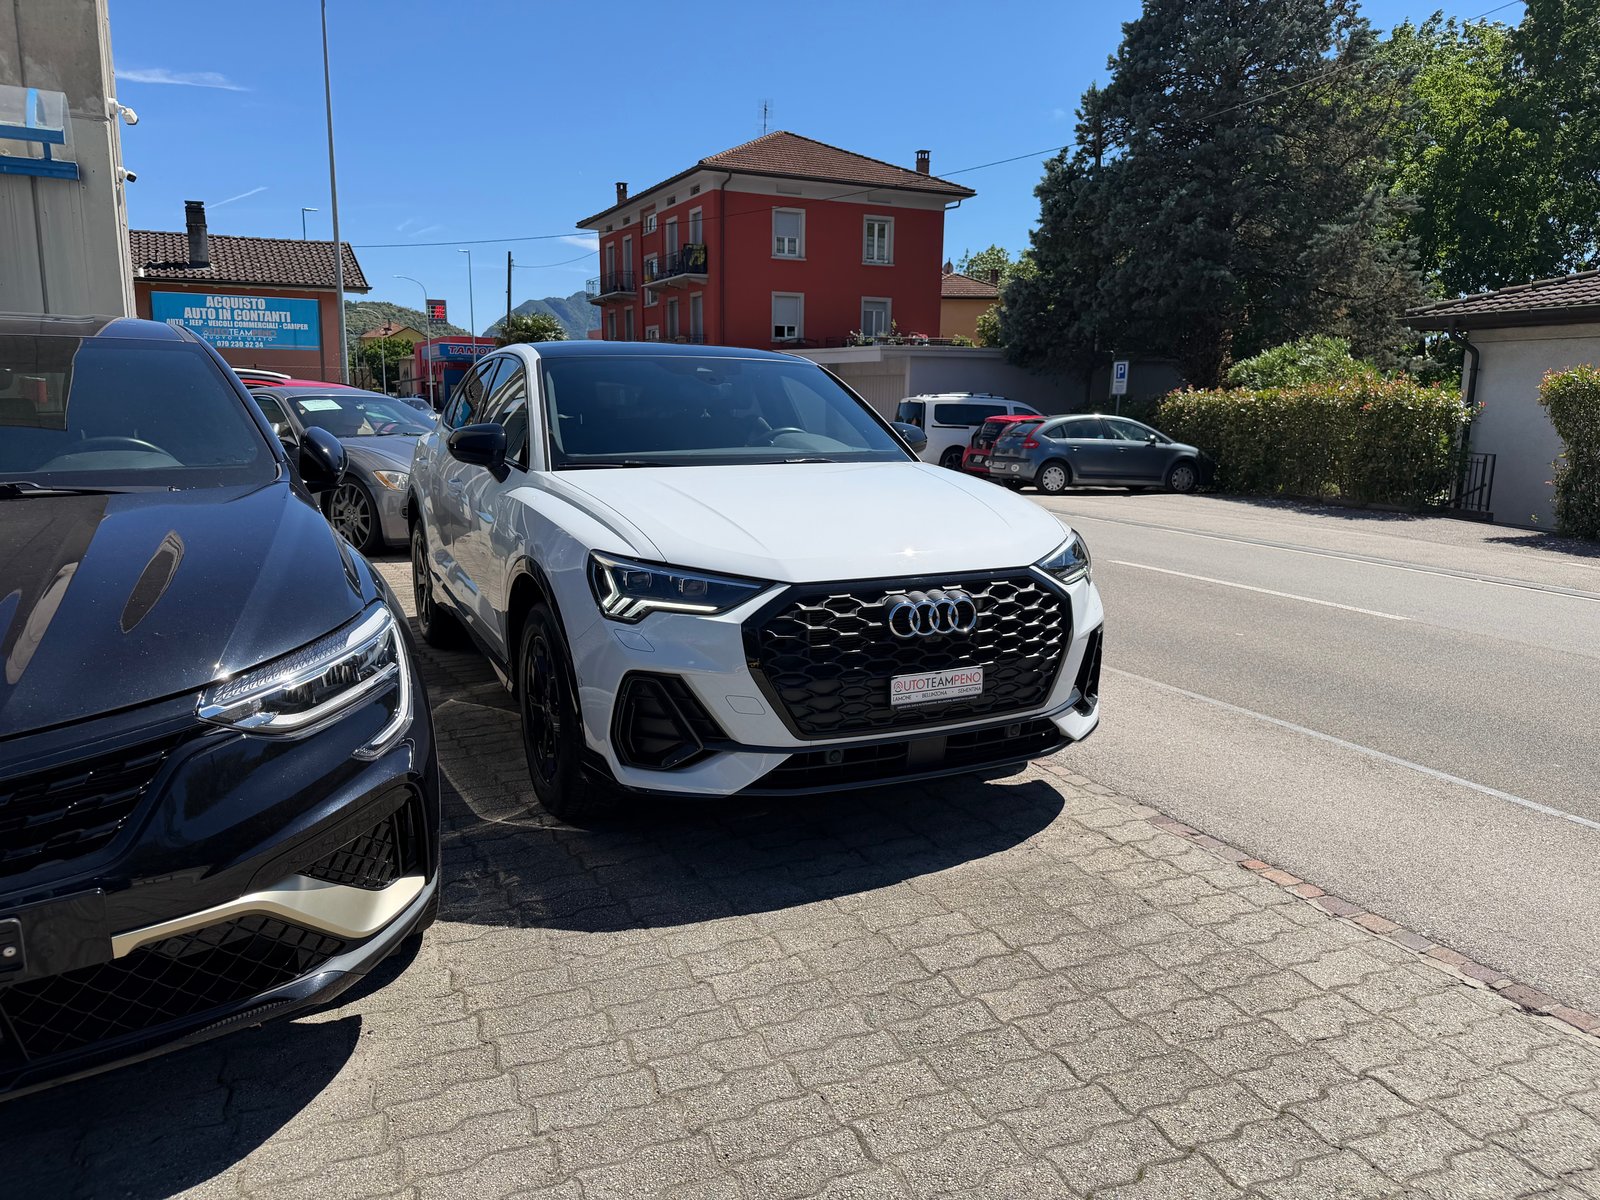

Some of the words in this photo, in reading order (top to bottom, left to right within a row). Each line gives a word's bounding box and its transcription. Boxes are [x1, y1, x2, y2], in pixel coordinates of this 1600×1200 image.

[206, 296, 266, 309] ACQUISTO
[184, 308, 216, 319] AUTO
[219, 309, 231, 320] IN
[234, 309, 291, 323] CONTANTI
[233, 321, 279, 329] COMMERCIALI
[449, 346, 496, 355] TAMOI
[1117, 364, 1125, 378] P
[958, 686, 981, 694] SEMENTINA
